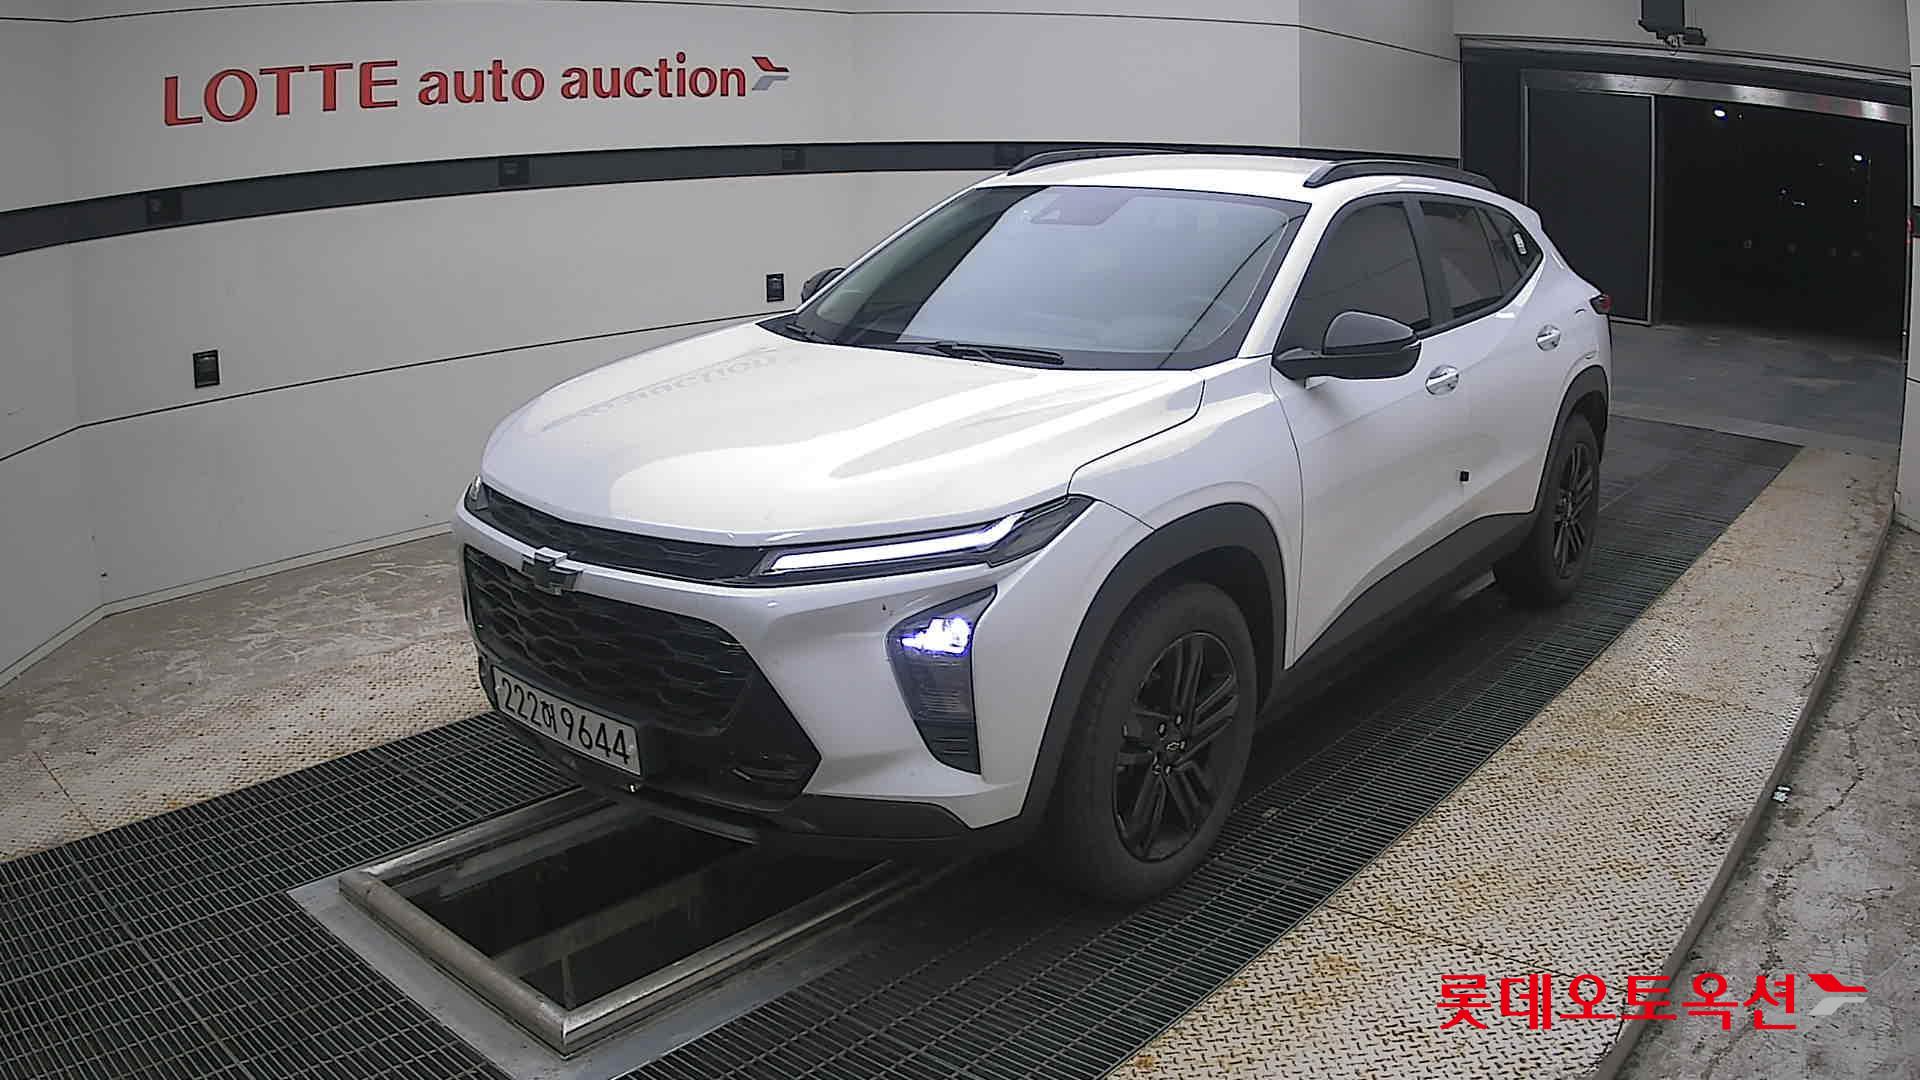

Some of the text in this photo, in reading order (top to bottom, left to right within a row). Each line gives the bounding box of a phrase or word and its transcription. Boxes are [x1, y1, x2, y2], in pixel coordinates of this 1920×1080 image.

[163, 51, 747, 127] LOTTE auto auction
